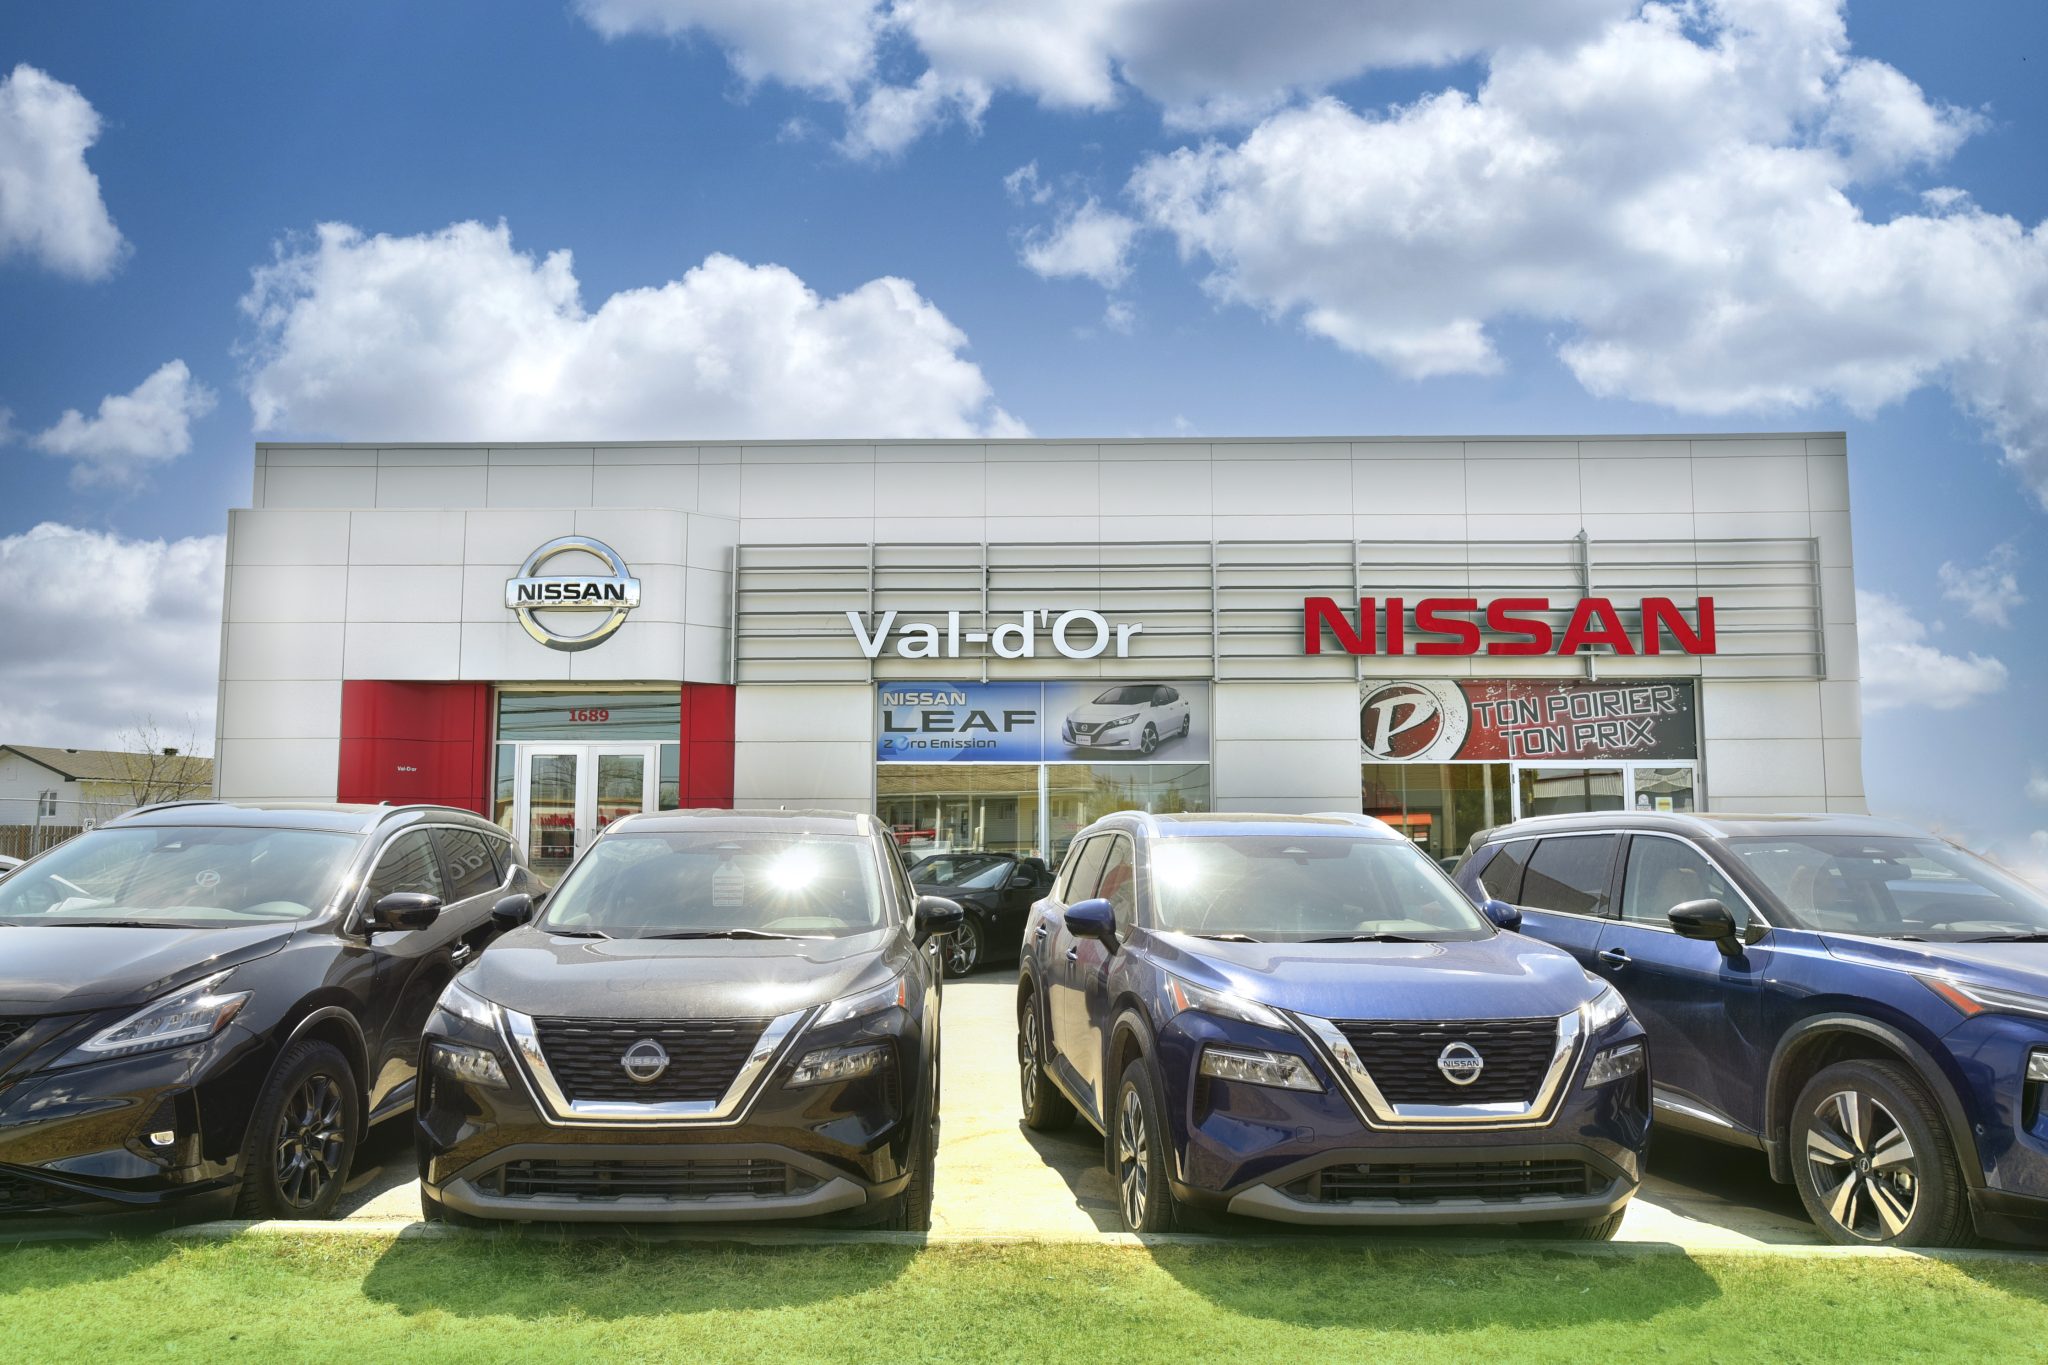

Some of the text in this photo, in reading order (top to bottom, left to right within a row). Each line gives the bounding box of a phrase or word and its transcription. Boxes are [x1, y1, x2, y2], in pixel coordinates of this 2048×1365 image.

[517, 583, 625, 601] NISSAN
[845, 608, 1143, 659] Val-d'Or
[1303, 596, 1717, 656] NISSAN
[882, 692, 967, 706] NISSAN
[1472, 685, 1677, 729] TON POIRIER
[568, 708, 609, 723] 1689
[883, 710, 1037, 733] LEAF
[1369, 693, 1436, 756] P
[930, 737, 997, 749] Emission
[1500, 717, 1656, 757] TON PRIX
[621, 1057, 669, 1066] NISSAN
[1443, 1059, 1480, 1068] NISSAN
